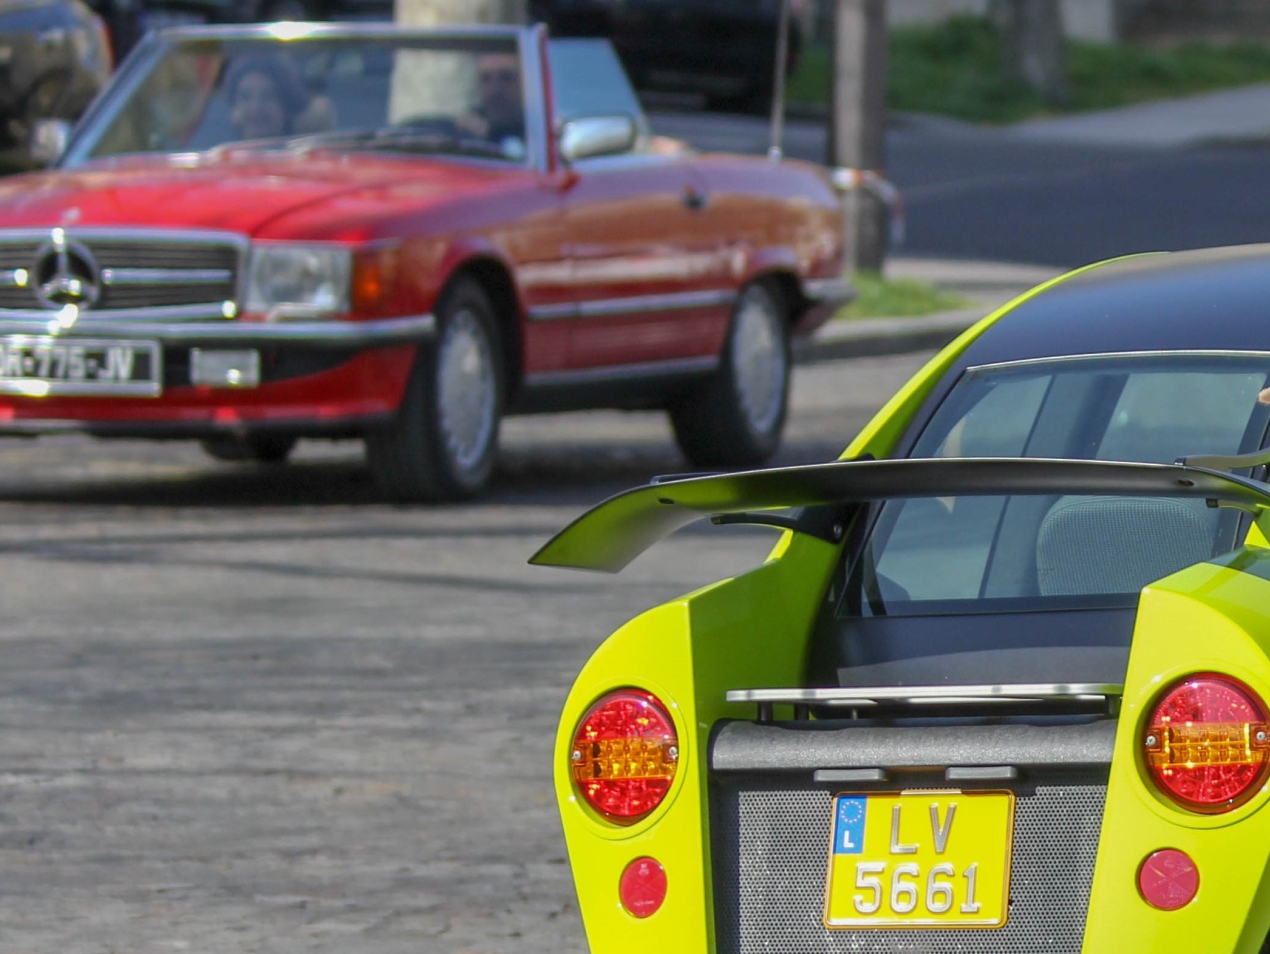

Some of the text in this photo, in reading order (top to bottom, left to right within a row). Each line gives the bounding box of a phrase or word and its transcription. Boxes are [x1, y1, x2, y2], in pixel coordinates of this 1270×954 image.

[0, 346, 134, 380] R-775-JV
[843, 830, 855, 848] L
[889, 802, 958, 854] LV
[852, 861, 982, 914] 5661
